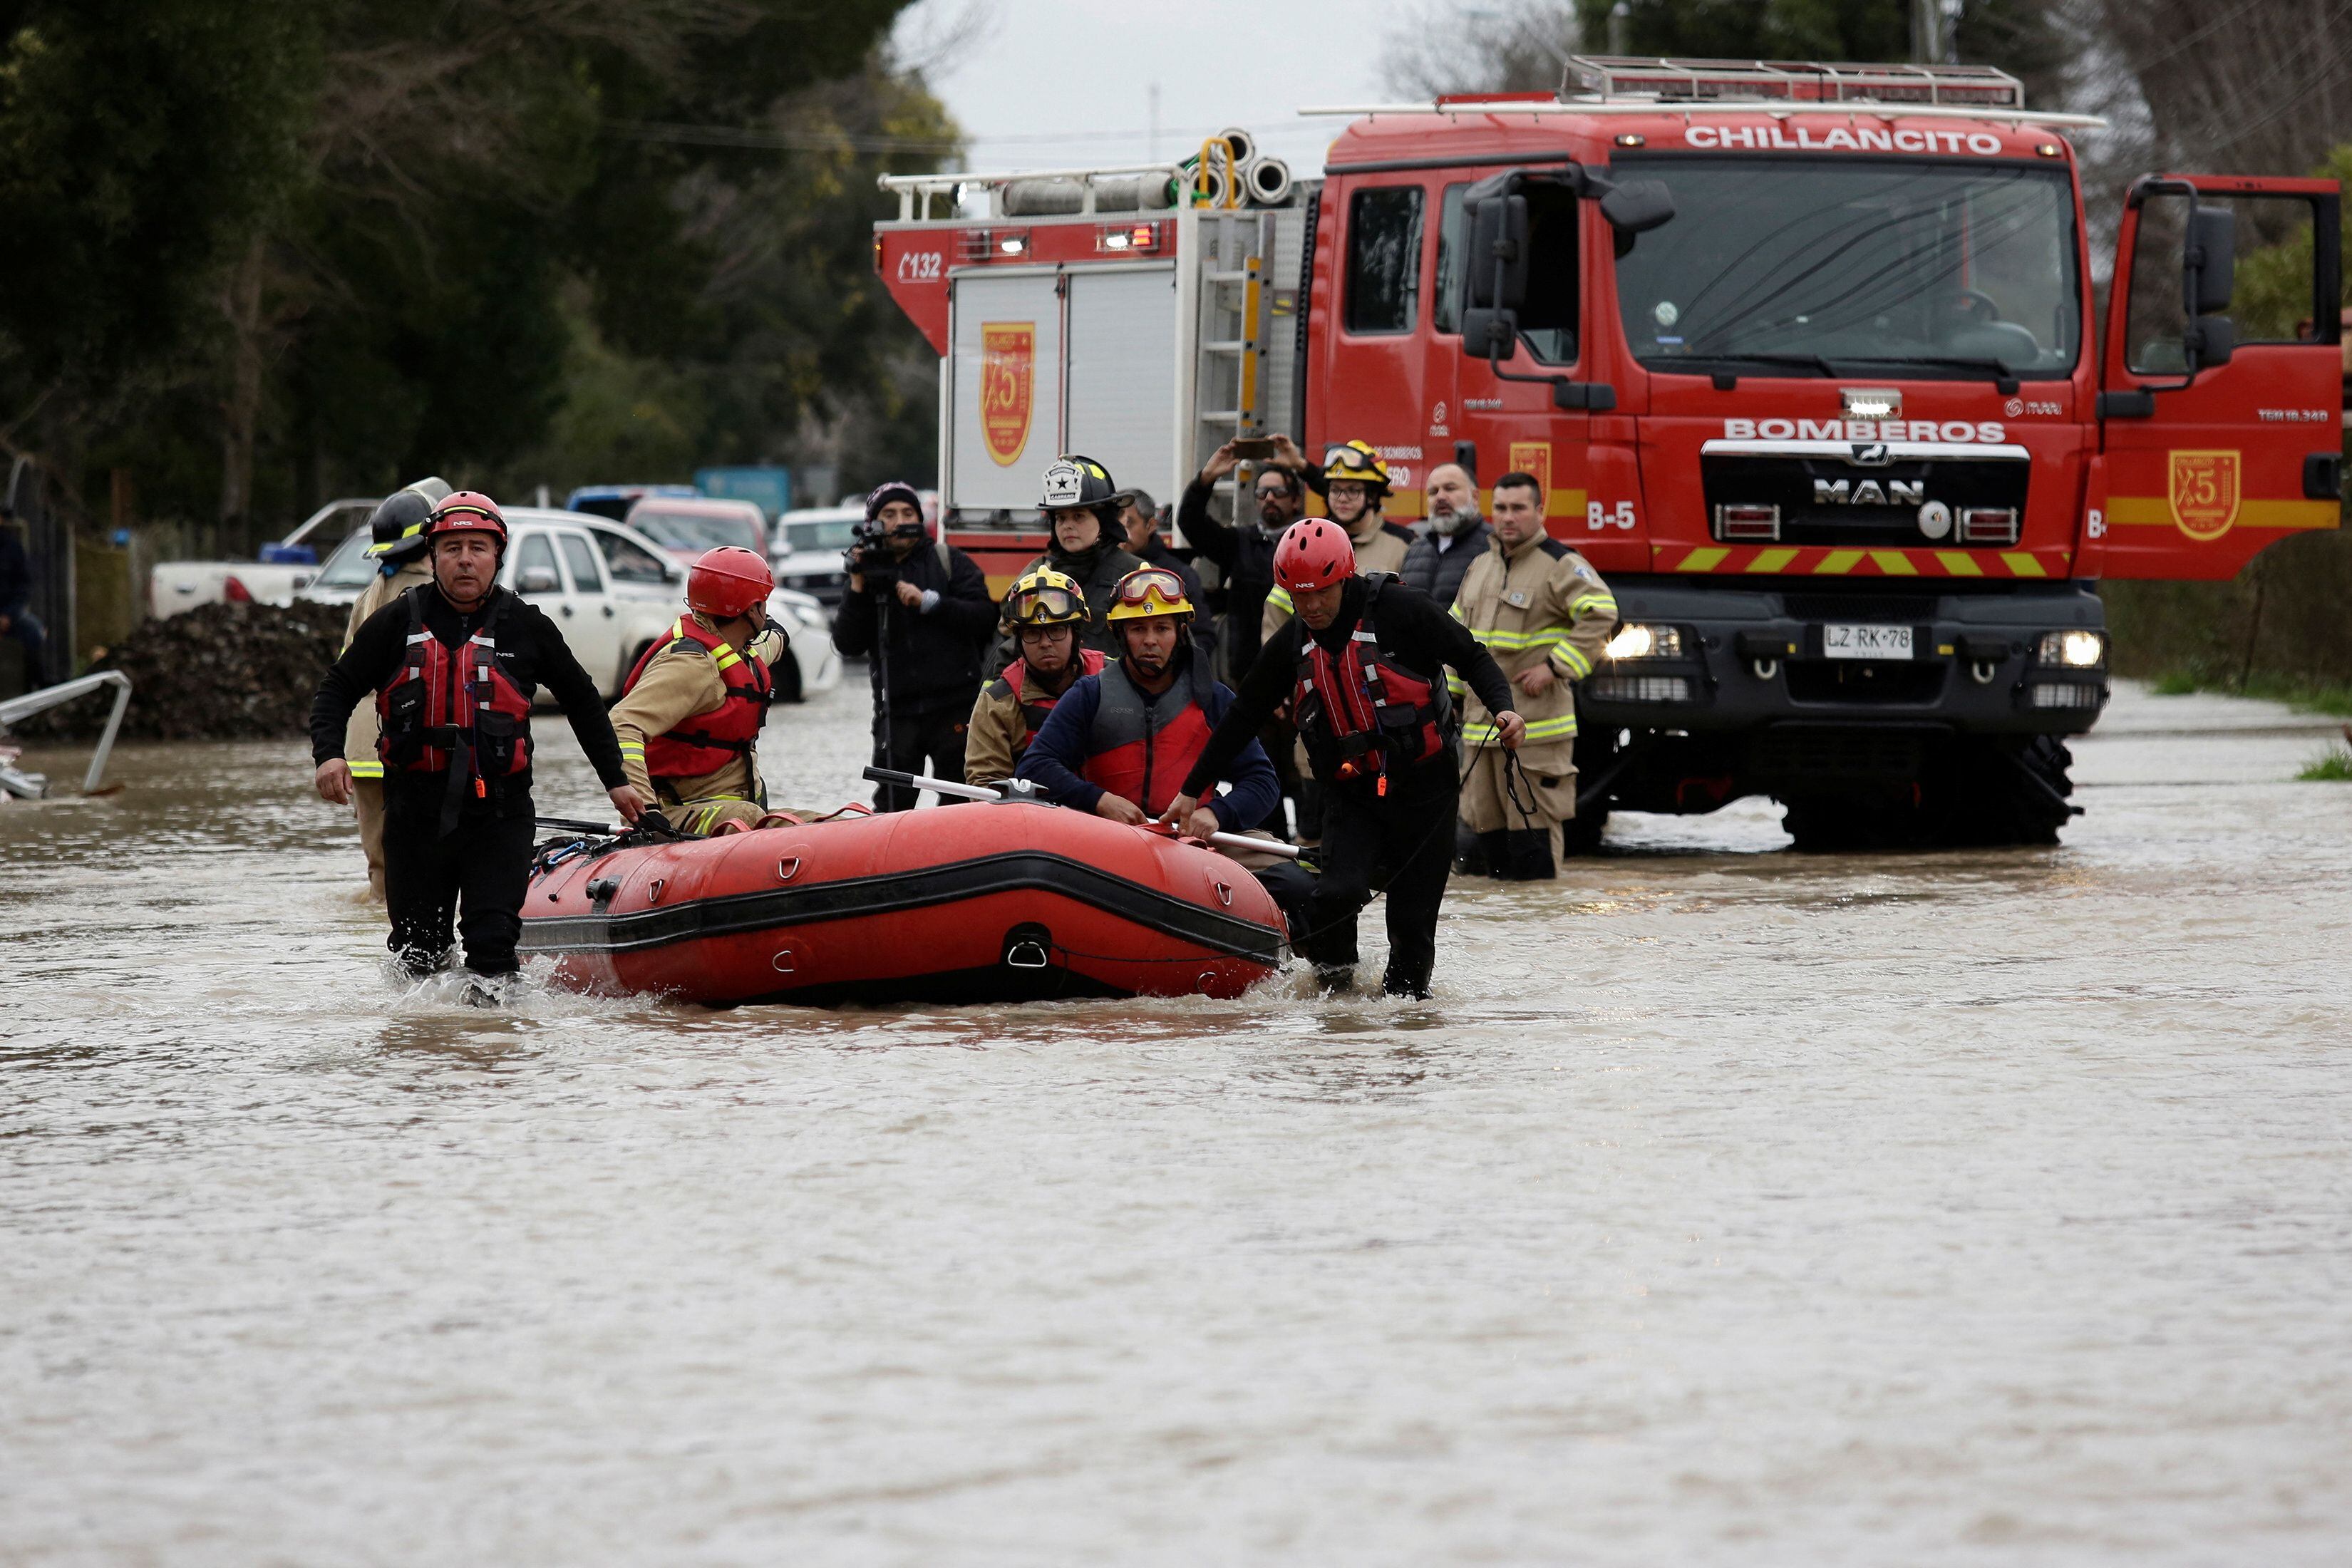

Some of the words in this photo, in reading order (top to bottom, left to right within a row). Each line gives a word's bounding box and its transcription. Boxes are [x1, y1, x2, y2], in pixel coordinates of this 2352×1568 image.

[1683, 125, 2002, 155] CHILLANCITO
[909, 252, 942, 279] 132
[1724, 418, 2006, 443] BOMBEROS
[1813, 478, 1924, 506] MAN
[2195, 470, 2217, 505] 5
[1587, 500, 1636, 530] B-5
[1826, 627, 1851, 648] LZ
[401, 699, 416, 709] NRS
